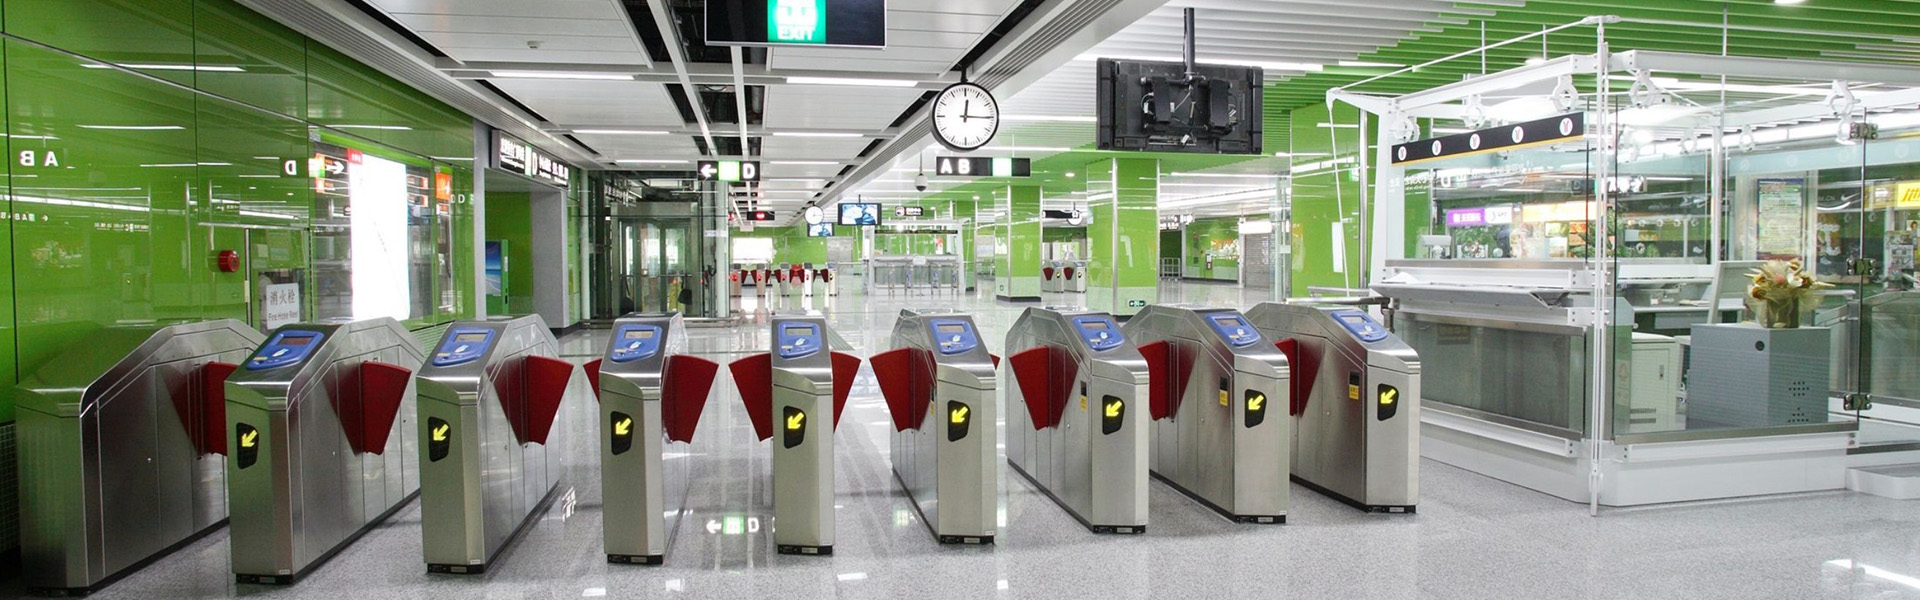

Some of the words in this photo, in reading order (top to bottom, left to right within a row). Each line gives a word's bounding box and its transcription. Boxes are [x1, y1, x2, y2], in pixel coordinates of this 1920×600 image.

[777, 26, 814, 41] EXIT
[532, 152, 538, 175] D
[742, 163, 756, 179] D
[940, 158, 953, 175] A
[957, 158, 970, 175] B
[269, 289, 296, 306] 消火栓
